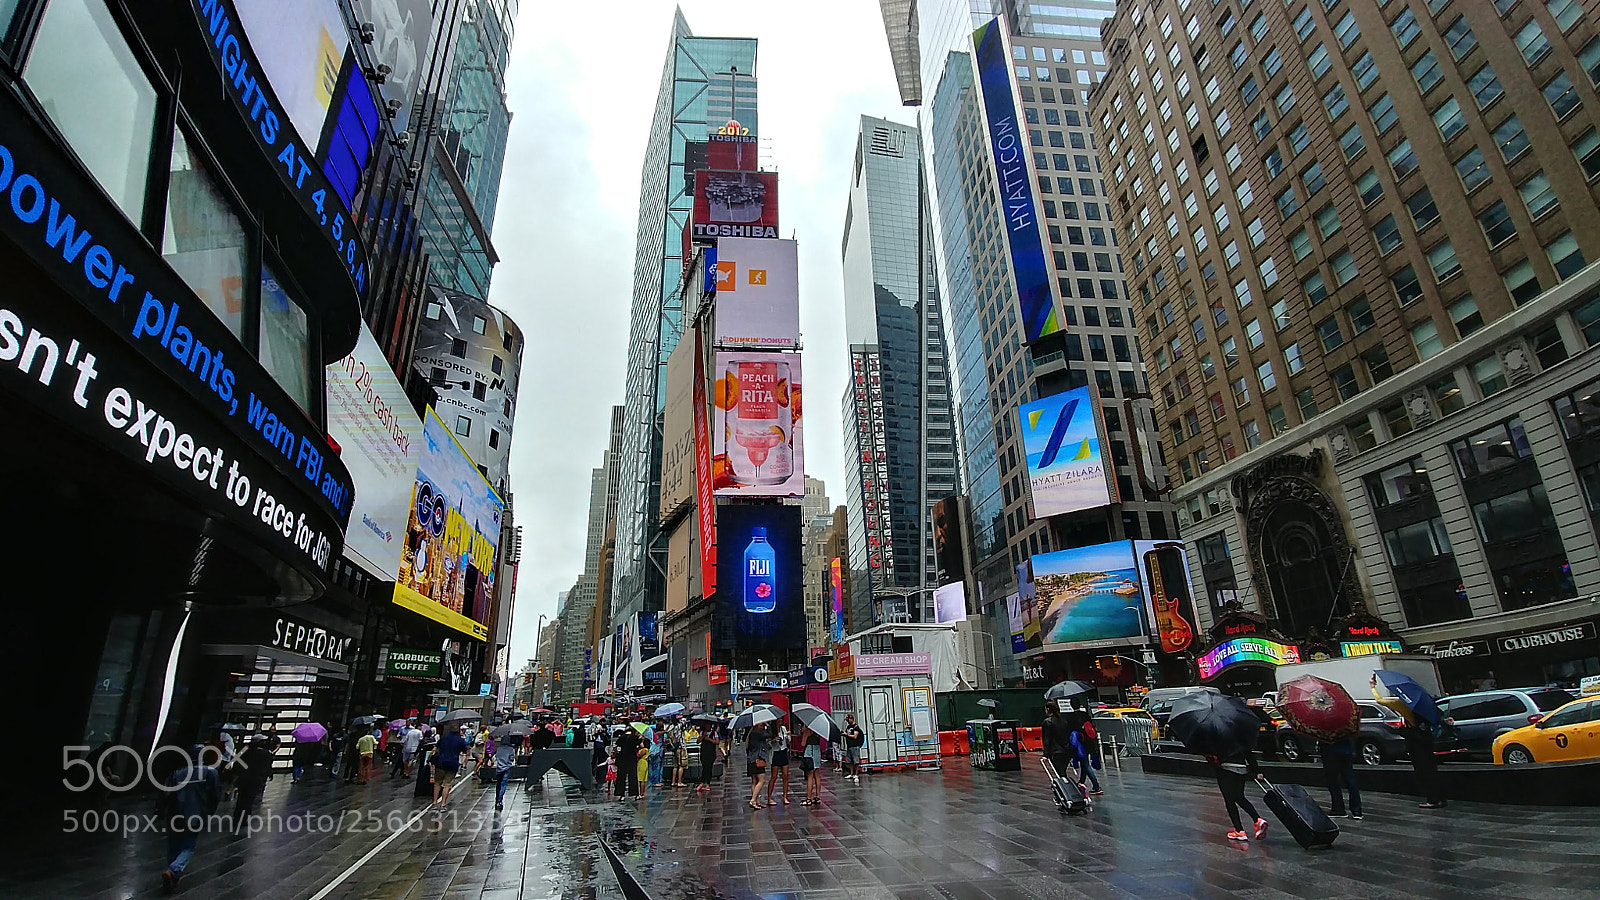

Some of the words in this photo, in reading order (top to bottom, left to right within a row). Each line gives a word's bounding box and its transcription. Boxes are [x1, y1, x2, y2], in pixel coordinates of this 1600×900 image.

[710, 134, 757, 143] TOSHIBA
[718, 126, 750, 137] 2017
[994, 115, 1031, 232] HYATT.COM
[277, 142, 312, 189] AT
[311, 187, 327, 226] 4,
[331, 212, 345, 252] 5,
[346, 238, 356, 275] 6,
[694, 223, 777, 238] TOSHIBA
[474, 371, 489, 383] BY:
[742, 373, 774, 383] PEACH
[132, 291, 238, 417] plants,
[247, 392, 295, 460] warn
[296, 435, 324, 487] FBI
[321, 472, 345, 510] and
[742, 390, 774, 403] RITA
[355, 361, 373, 404] 2%
[373, 395, 393, 434] cash
[392, 416, 410, 458] back
[104, 387, 225, 489] expect
[225, 460, 251, 507] to
[252, 487, 294, 538] race
[294, 513, 315, 553] for
[312, 531, 331, 573] JGR
[1031, 473, 1061, 487] HYATT
[1065, 465, 1101, 480] ZILARA
[865, 479, 882, 569] YOUNG
[749, 559, 770, 575] FIJI
[1225, 624, 1240, 635] Hard
[1240, 622, 1257, 634] Rock
[1348, 627, 1364, 635] Hard
[1364, 627, 1380, 636] Rock
[272, 618, 343, 661] SEPHORA
[1504, 627, 1584, 650] CLUBHOUSE
[856, 657, 871, 666] ICE
[872, 656, 903, 665] CREAM
[904, 655, 928, 663] SHOP
[1212, 652, 1227, 667] LOVE
[1226, 644, 1240, 656] ALL
[1240, 642, 1264, 654] SERVE
[1264, 647, 1280, 660] ALL
[394, 662, 429, 671] COFFEE
